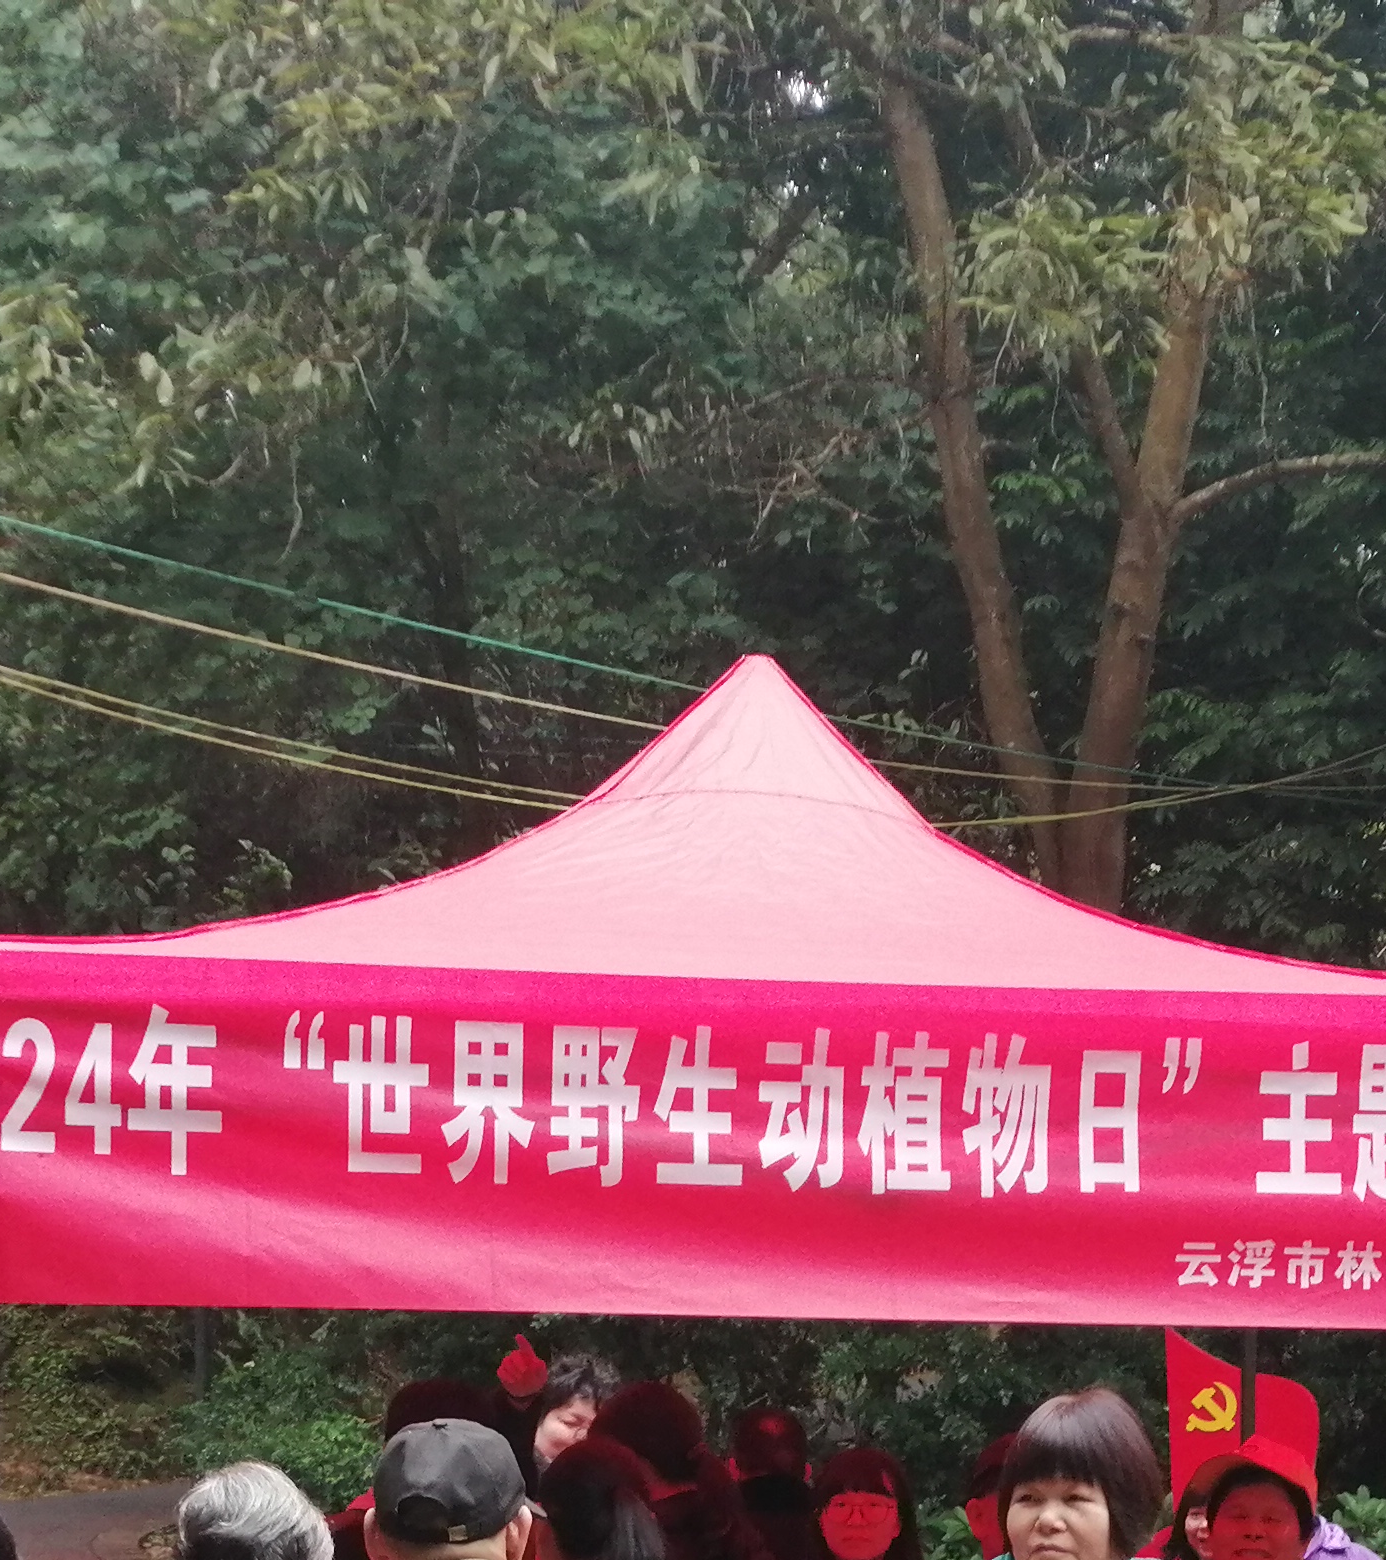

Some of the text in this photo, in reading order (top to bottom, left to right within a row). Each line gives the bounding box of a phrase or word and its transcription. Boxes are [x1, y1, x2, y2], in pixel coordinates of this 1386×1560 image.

[283, 1009, 1202, 1198] “世界野生动植物日”
